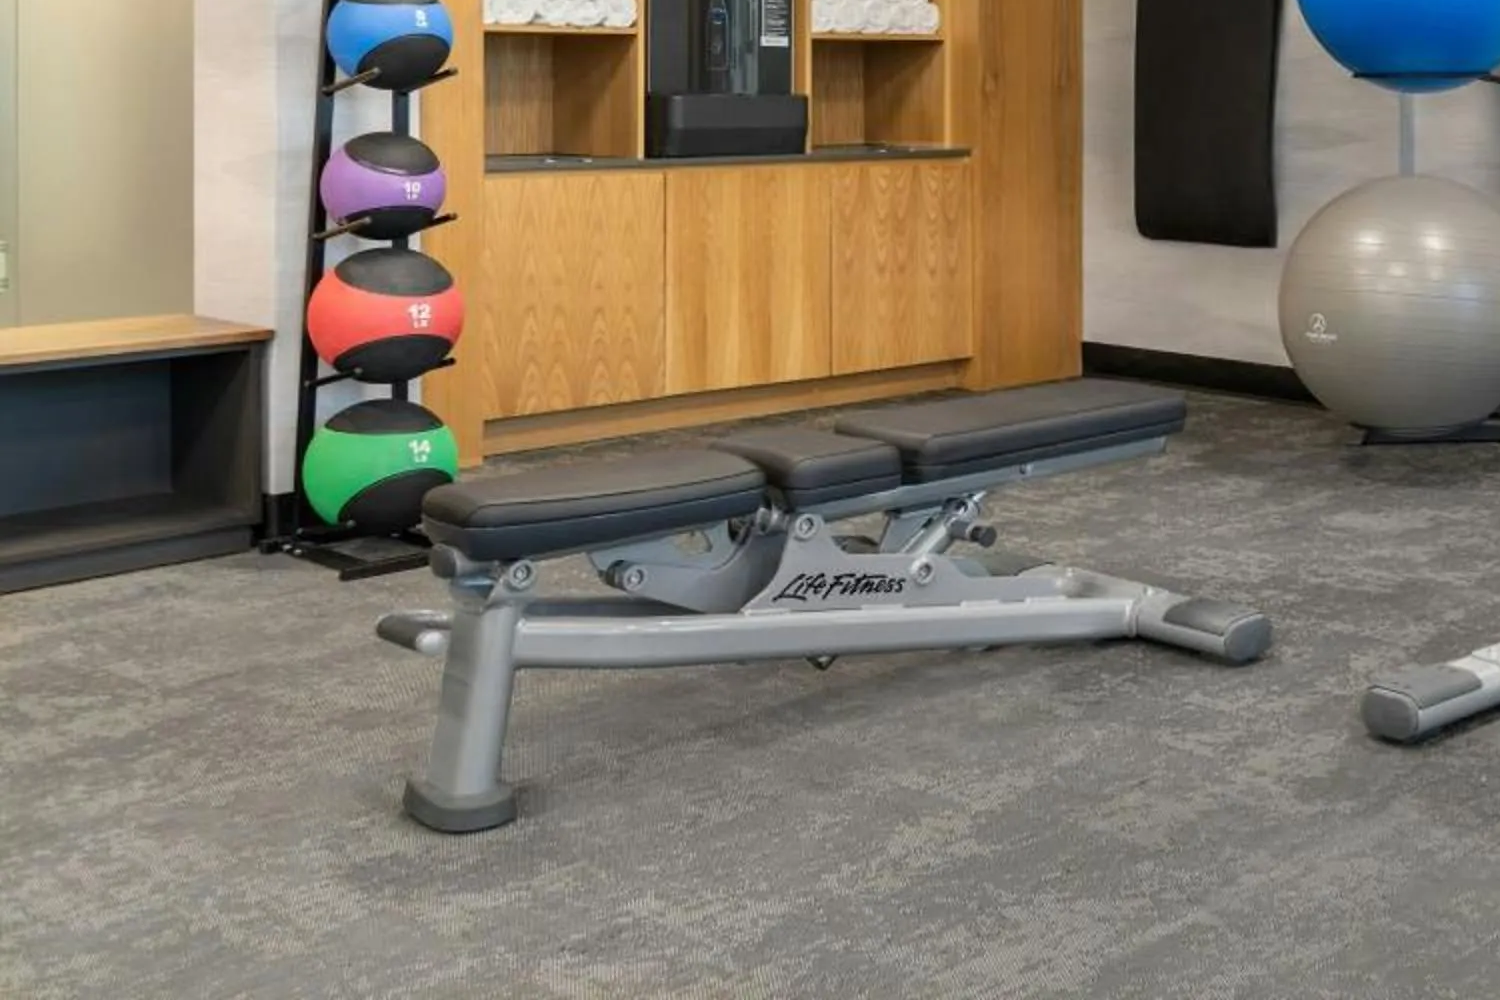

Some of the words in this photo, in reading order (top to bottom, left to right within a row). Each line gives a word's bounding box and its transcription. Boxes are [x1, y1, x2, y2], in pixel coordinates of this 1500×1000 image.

[404, 180, 421, 193] 10
[407, 303, 431, 320] 12
[407, 439, 431, 454] 14
